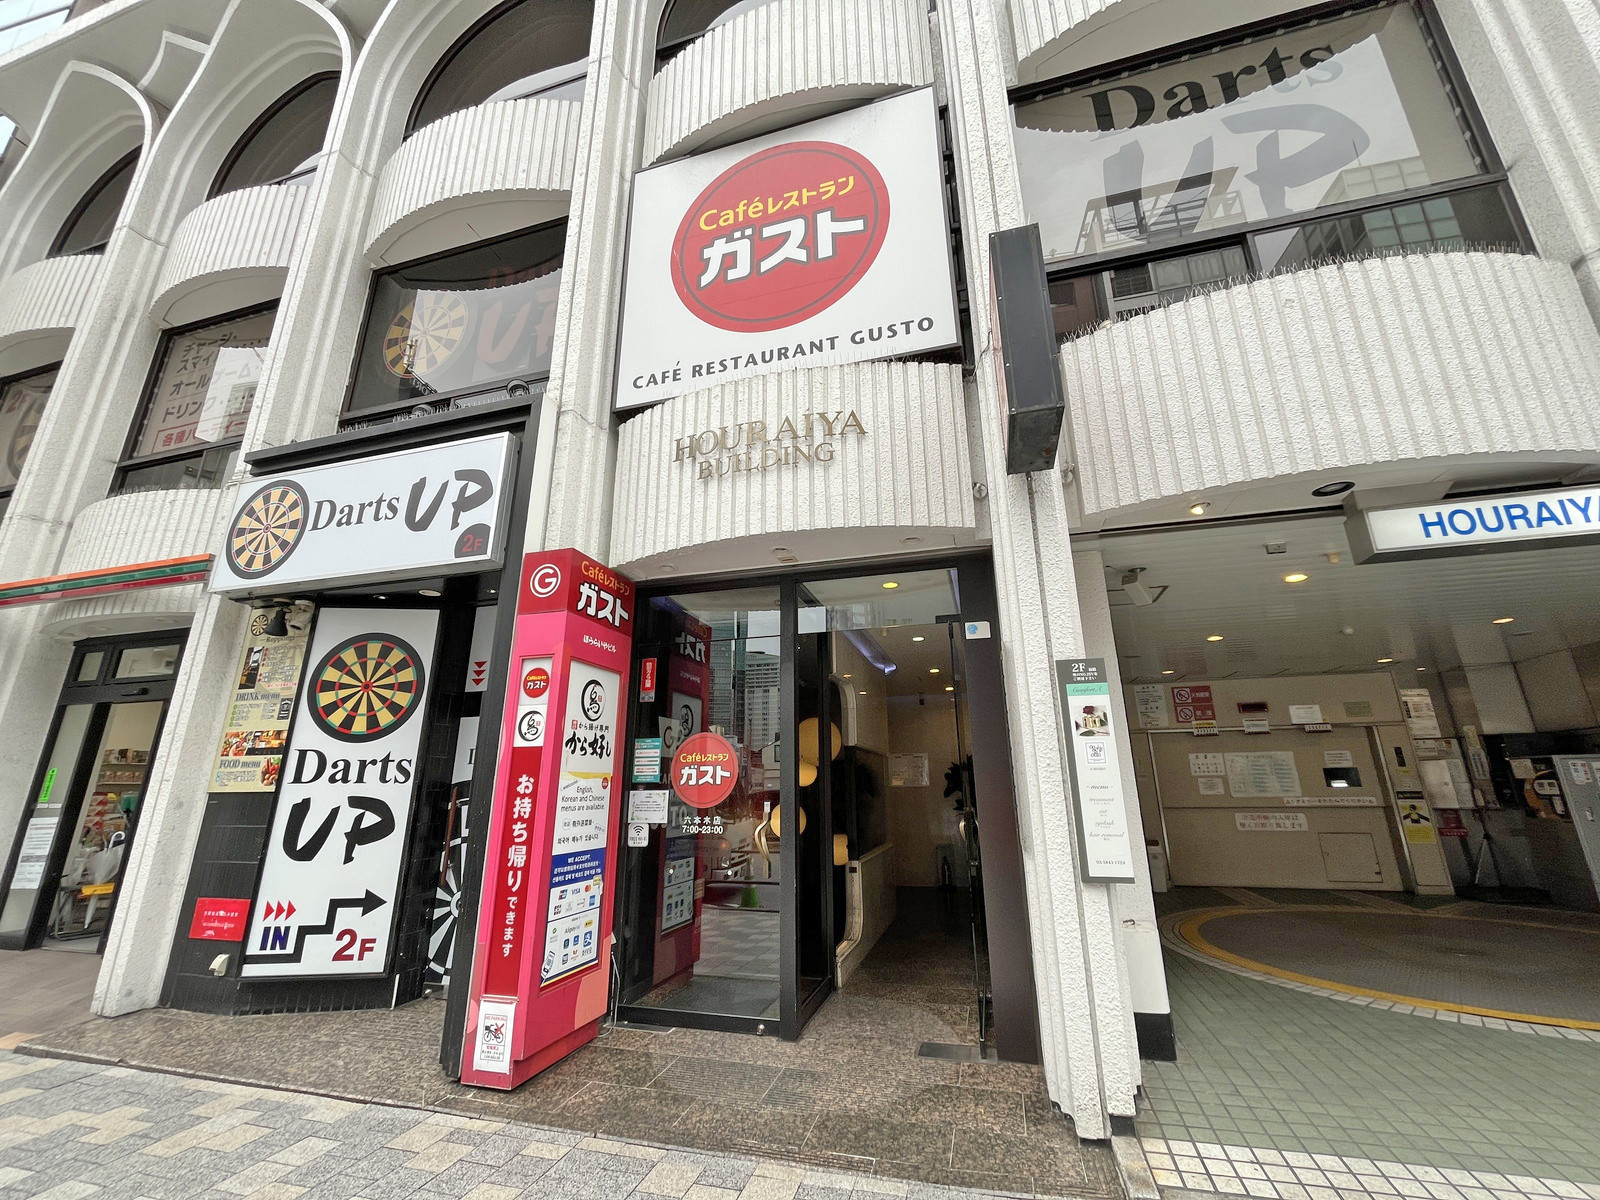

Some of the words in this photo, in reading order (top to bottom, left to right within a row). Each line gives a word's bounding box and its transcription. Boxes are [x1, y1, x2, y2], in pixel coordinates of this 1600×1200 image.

[1082, 44, 1343, 142] Darts
[1103, 103, 1371, 244] UP
[699, 175, 856, 231] Caféレストラン
[697, 206, 867, 290] ガスト
[632, 360, 682, 389] CAFÉ
[691, 335, 840, 378] RESTAURANT
[850, 316, 935, 345] GUSTO
[673, 409, 868, 462] HOURAIYA
[698, 441, 836, 480] BUILDING
[308, 492, 400, 532] Darts
[404, 468, 494, 532] UP
[1418, 495, 1600, 538] HOURAIY
[461, 534, 483, 553] 2F
[577, 581, 629, 627] ガスト
[526, 680, 547, 690] ガスト
[1072, 662, 1086, 672] 2F
[565, 730, 612, 759] から好し
[680, 752, 729, 763] Caféレストラン
[287, 749, 412, 785] Darts
[679, 765, 731, 786] ガスト
[588, 794, 605, 802] Chinese
[282, 796, 396, 865] UP
[684, 816, 721, 825] 六本木店
[502, 774, 535, 958] お持ち帰りできます
[259, 926, 291, 951] IN
[332, 928, 377, 962] 2F
